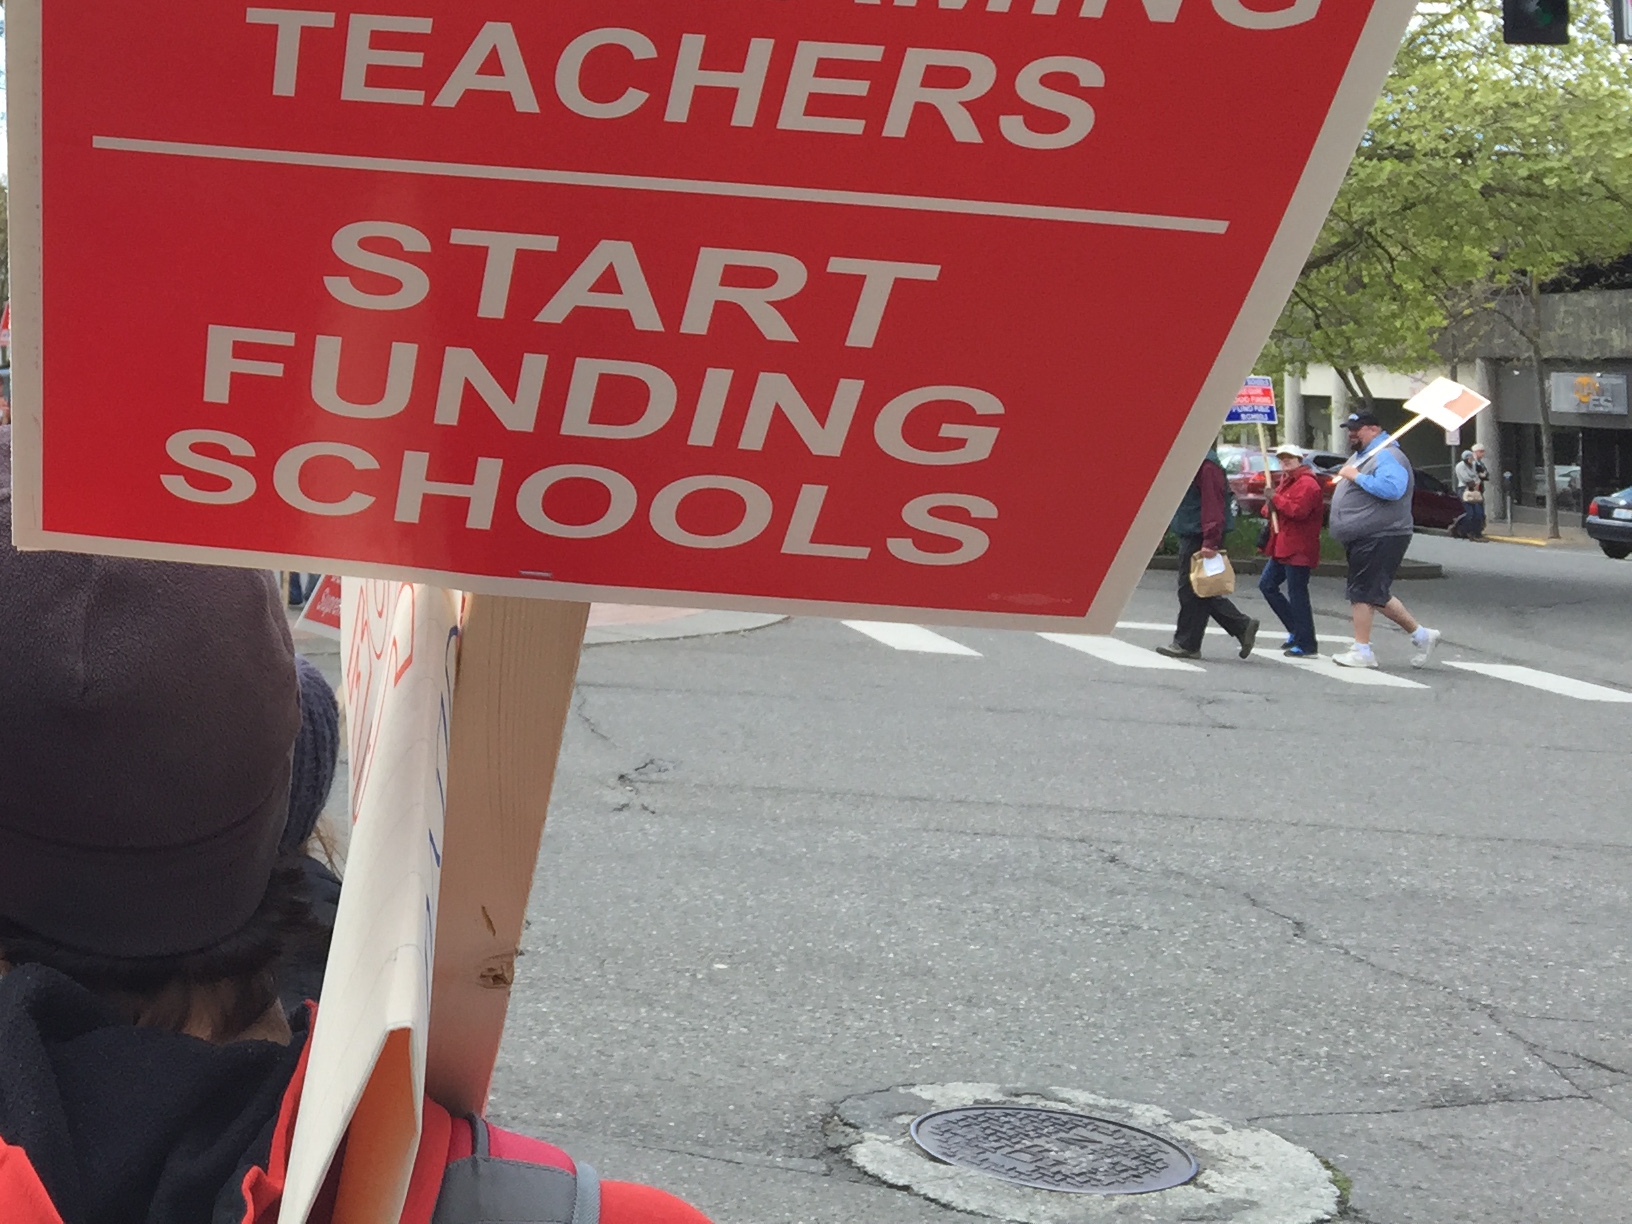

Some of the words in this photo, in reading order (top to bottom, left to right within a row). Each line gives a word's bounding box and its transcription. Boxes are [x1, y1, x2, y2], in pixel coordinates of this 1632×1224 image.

[246, 8, 1105, 149] TEACHERS
[324, 221, 941, 348] START
[204, 325, 1004, 465] FUNDING
[160, 429, 998, 565] SCHOOLS
